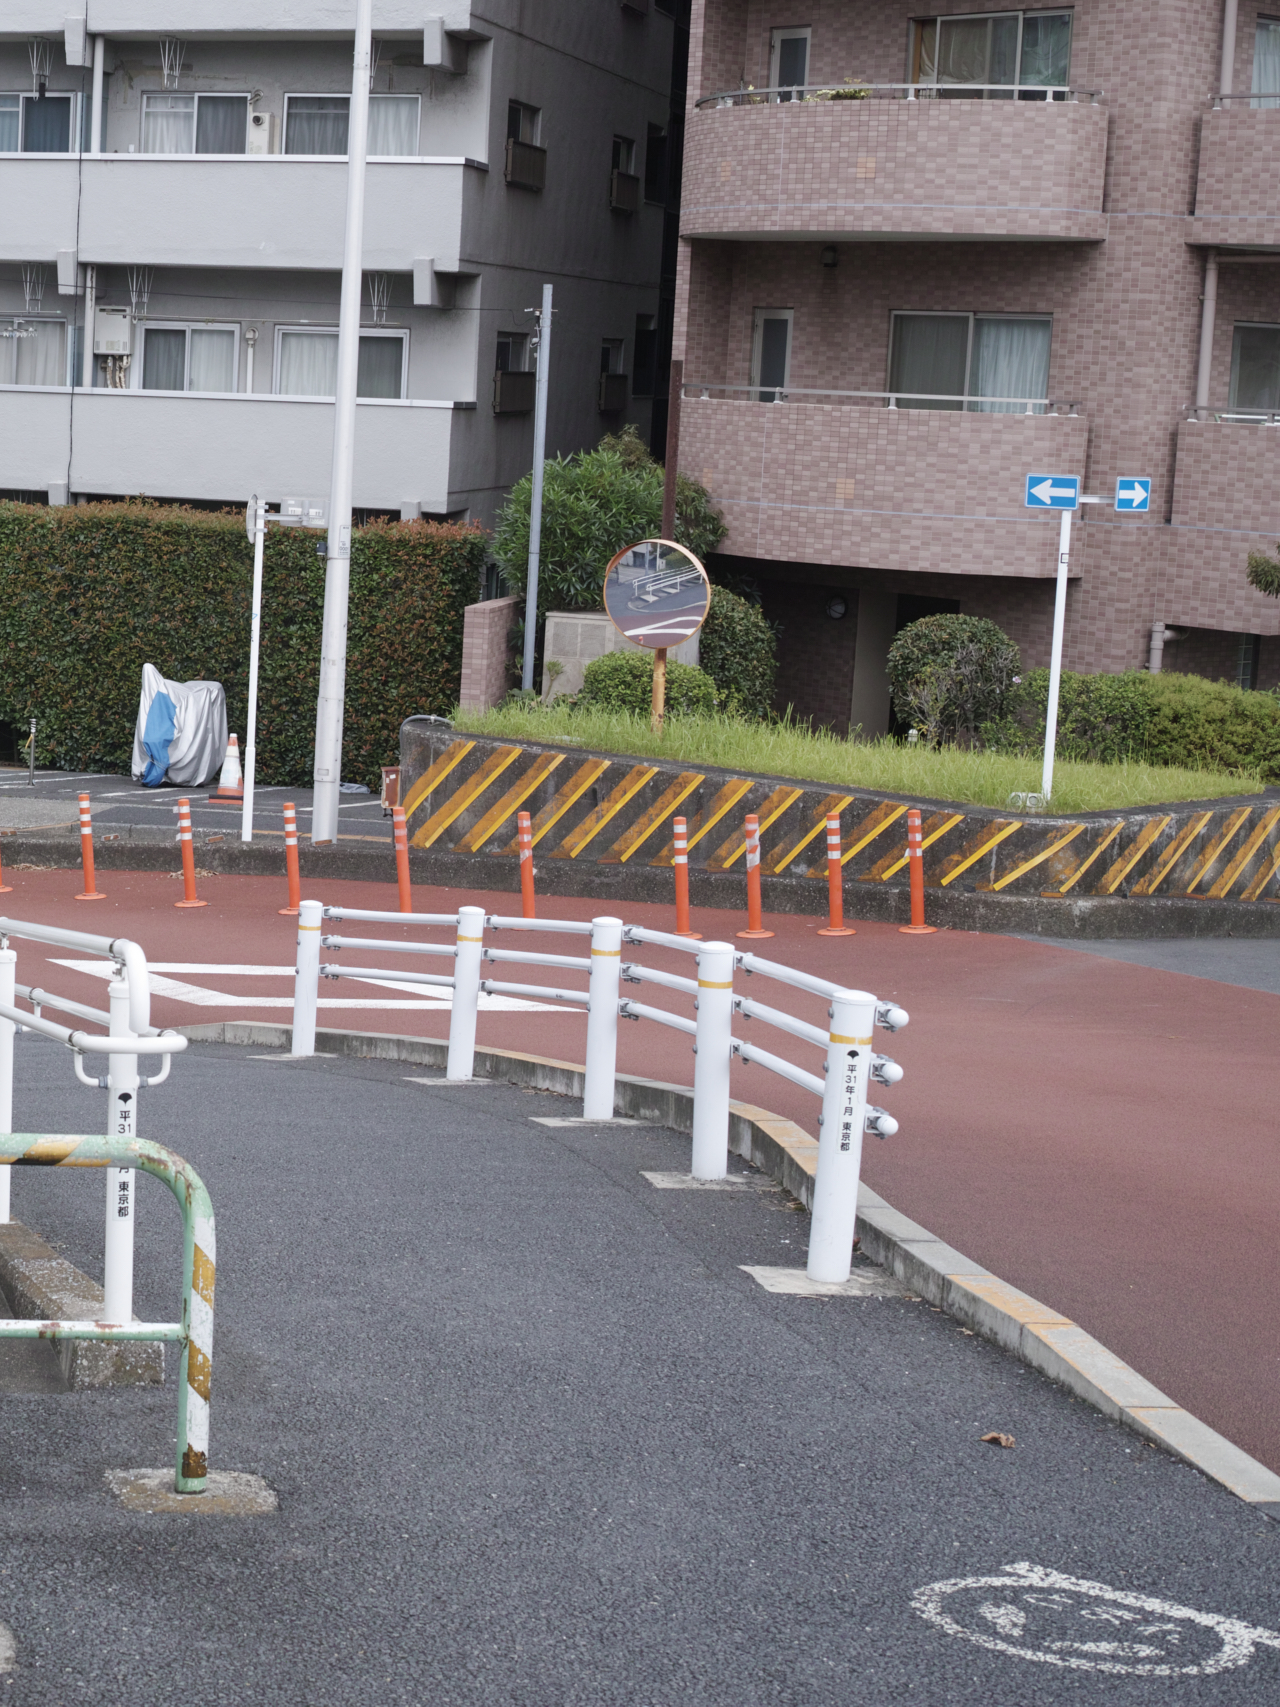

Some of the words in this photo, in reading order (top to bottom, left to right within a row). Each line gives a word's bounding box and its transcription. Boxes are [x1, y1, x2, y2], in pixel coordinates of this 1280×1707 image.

[843, 1064, 857, 1116] 平31年1月
[840, 1121, 852, 1152] 東京都
[117, 1181, 130, 1218] 東京都
